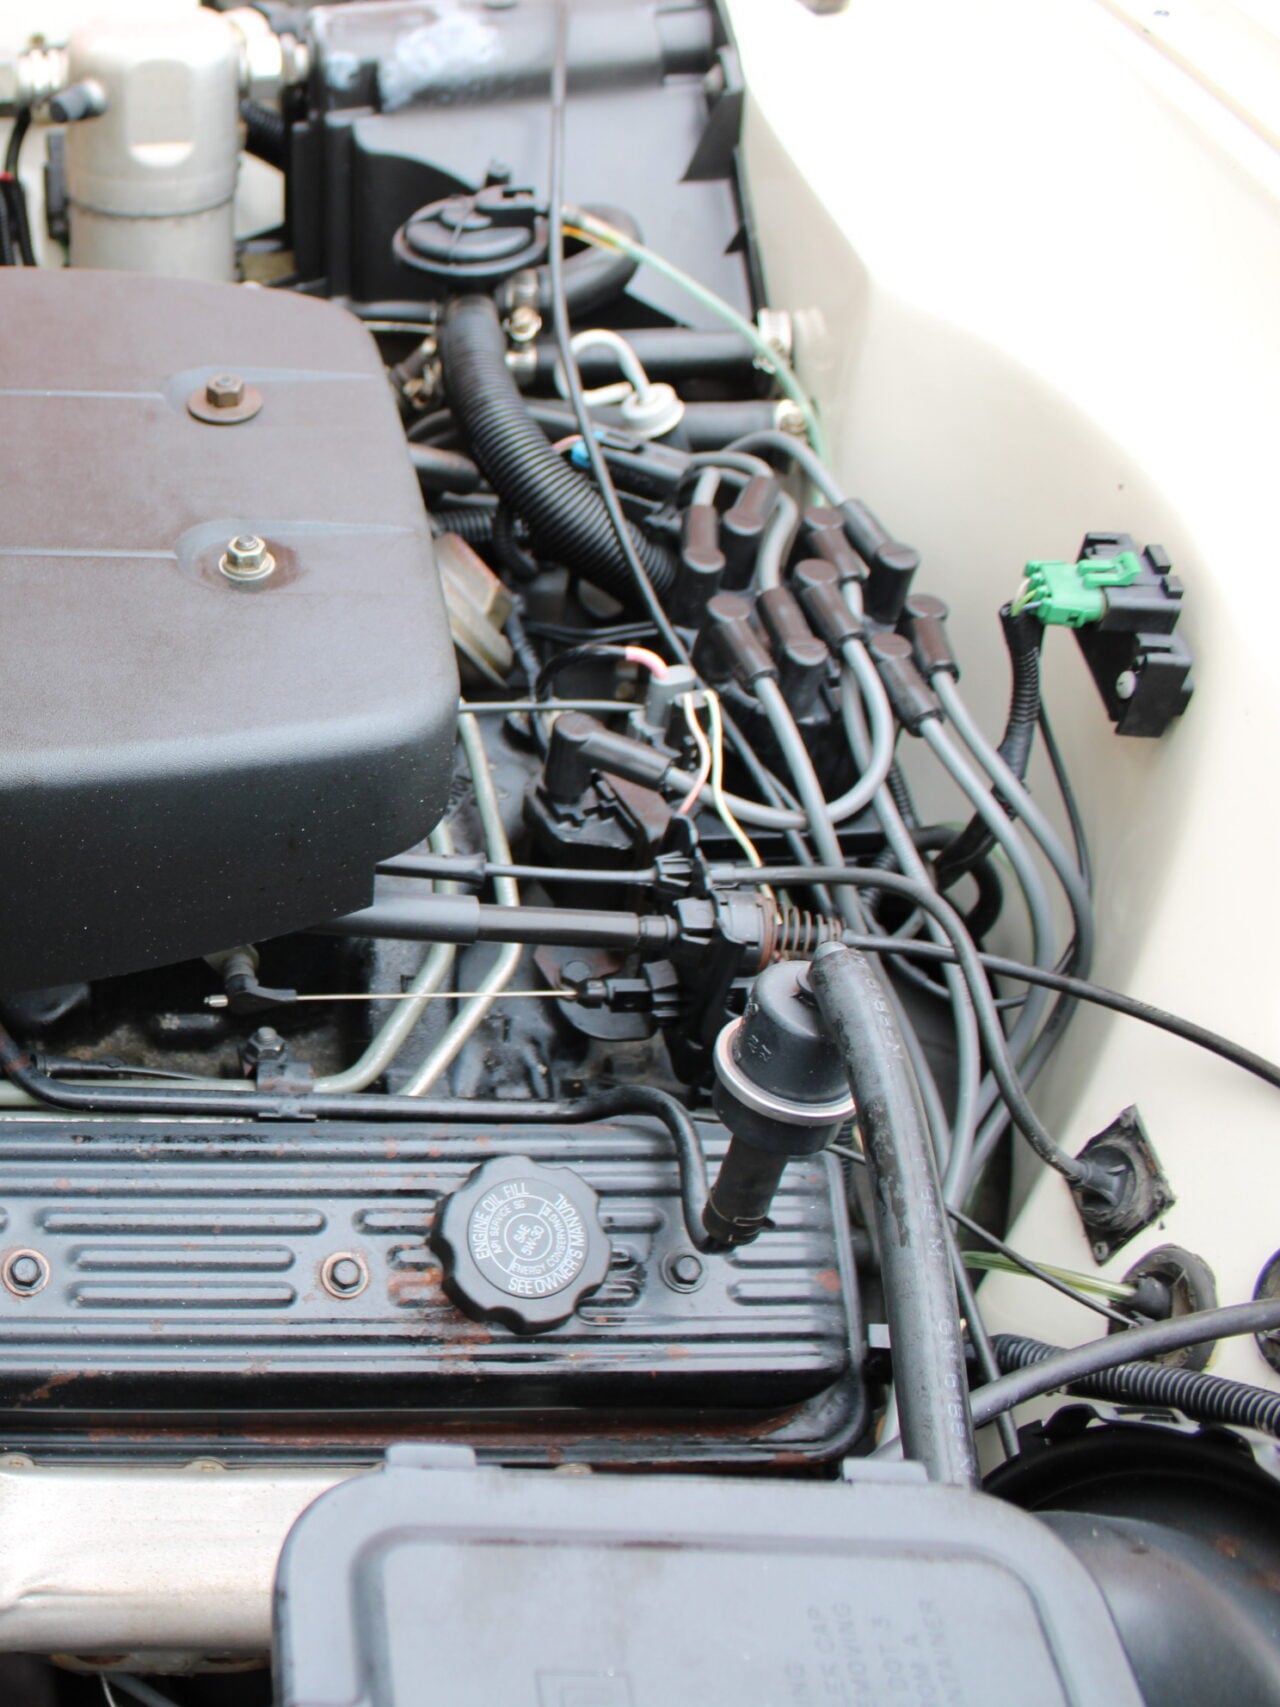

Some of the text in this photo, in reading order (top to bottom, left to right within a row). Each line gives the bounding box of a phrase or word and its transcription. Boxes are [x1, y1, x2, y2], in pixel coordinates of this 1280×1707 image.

[472, 1182, 530, 1260] ENGINE OIL FILL
[489, 1204, 512, 1237] SERVICE
[508, 1193, 585, 1295] SEE OWNER'S MANUAL
[511, 1262, 546, 1276] ENERGY
[546, 1213, 568, 1268] CONSERVING
[513, 1223, 531, 1244] SAE
[521, 1225, 545, 1256] 5W-30
[490, 1239, 503, 1254] API
[806, 1604, 836, 1654] CAP
[917, 1597, 965, 1707] NTAINER
